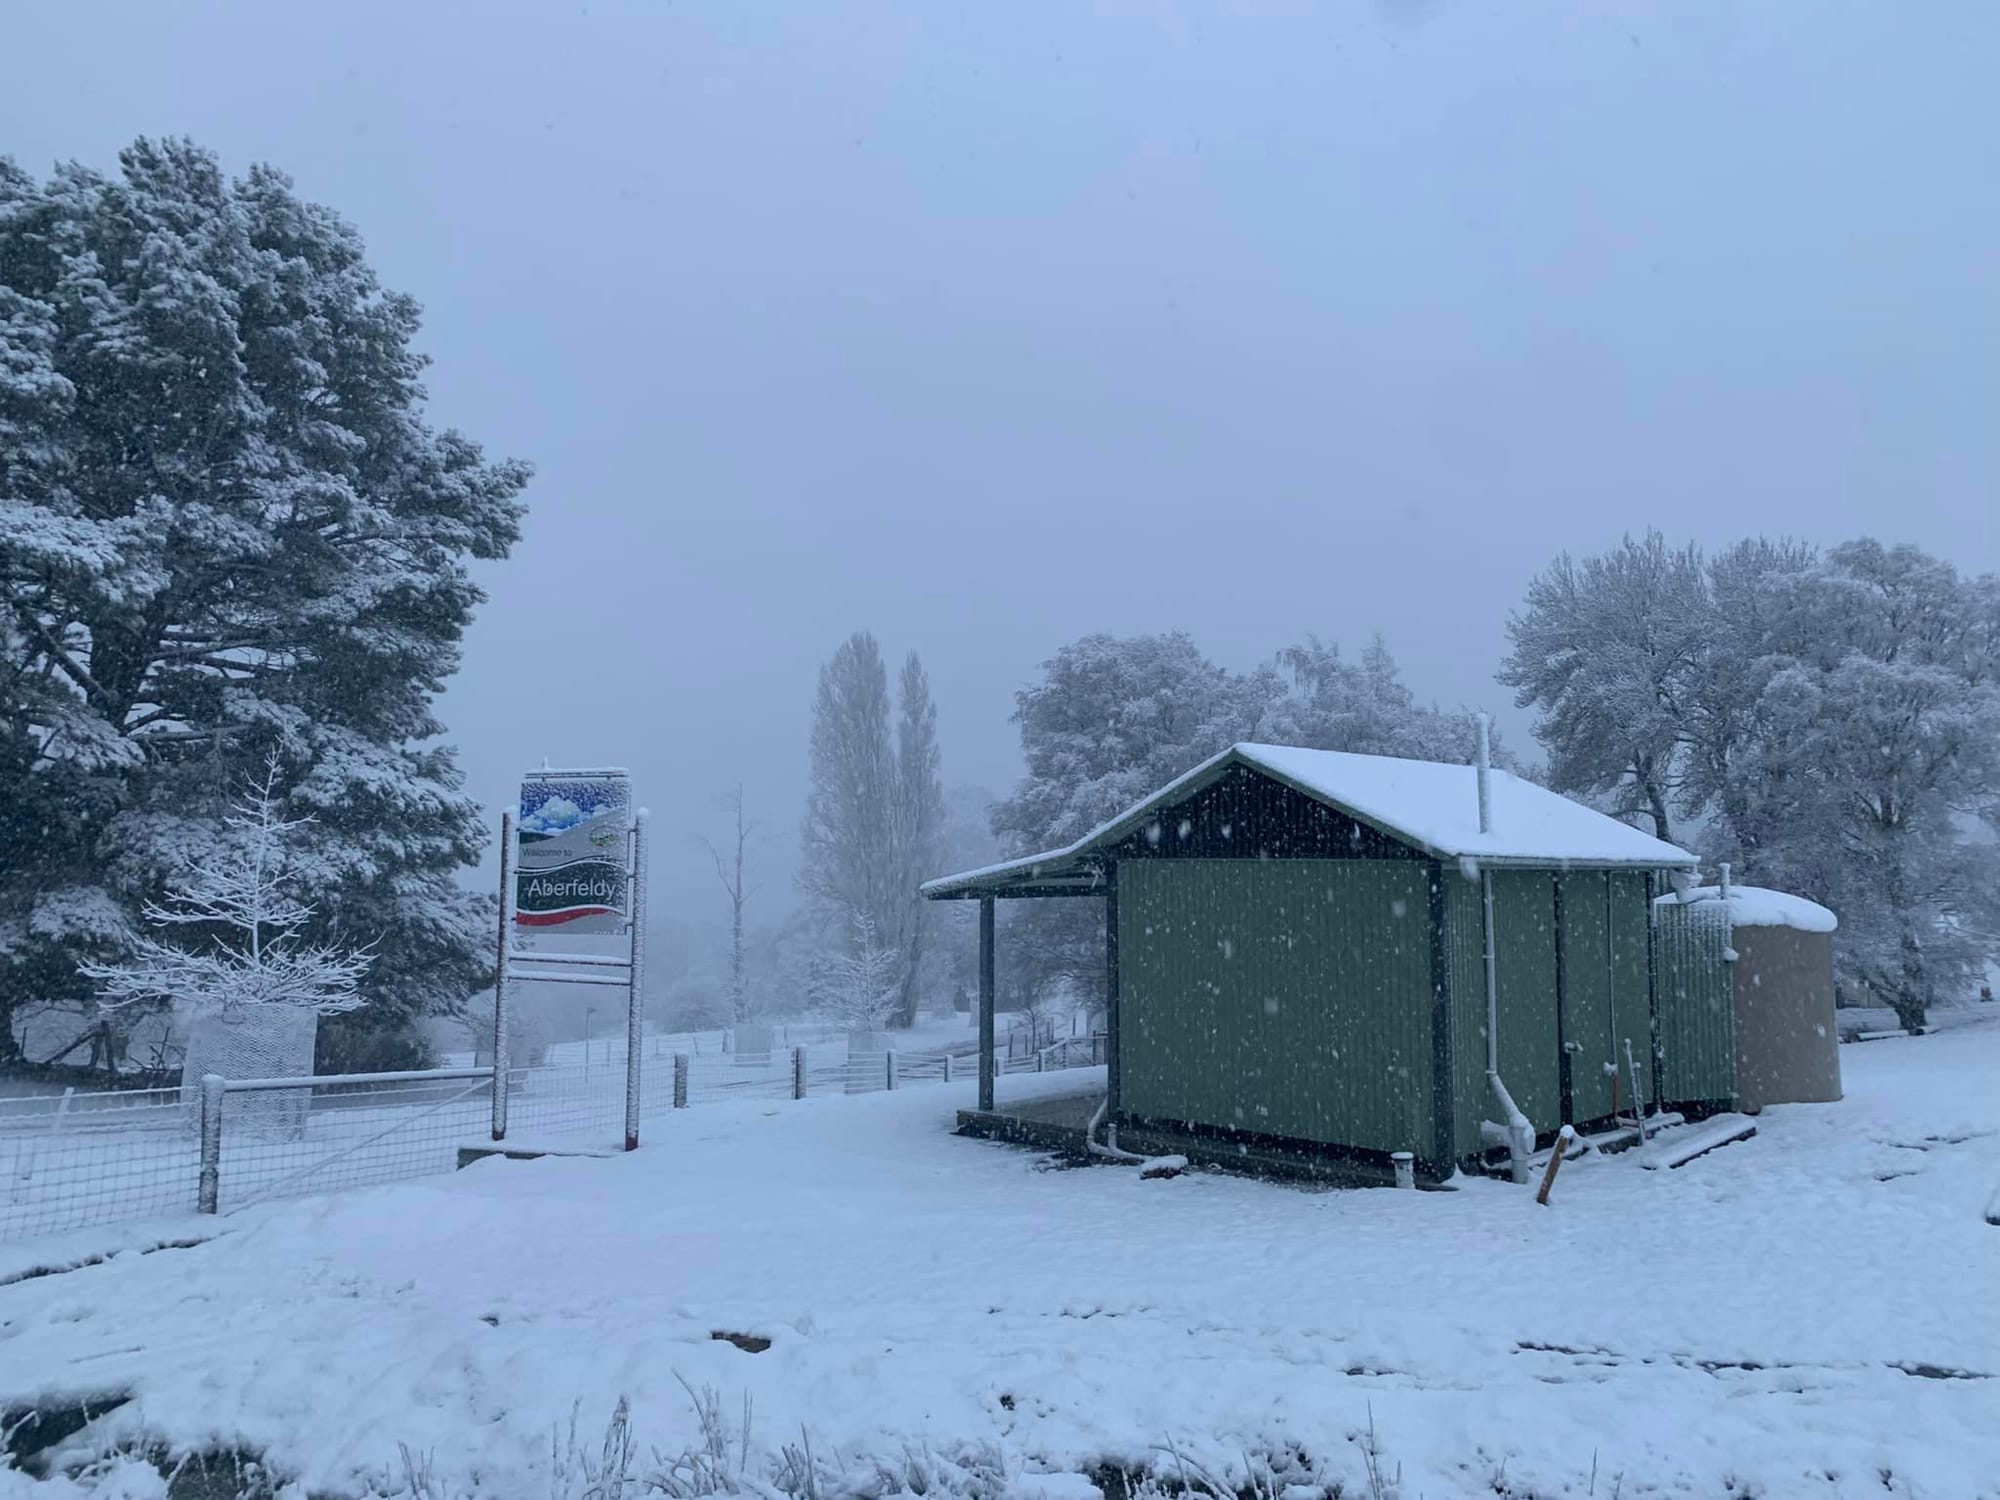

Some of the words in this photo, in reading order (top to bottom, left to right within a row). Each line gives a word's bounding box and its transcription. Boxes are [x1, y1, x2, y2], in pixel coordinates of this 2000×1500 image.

[522, 847, 562, 857] Welcome
[563, 848, 573, 857] to
[528, 878, 616, 901] Aberfeldy
